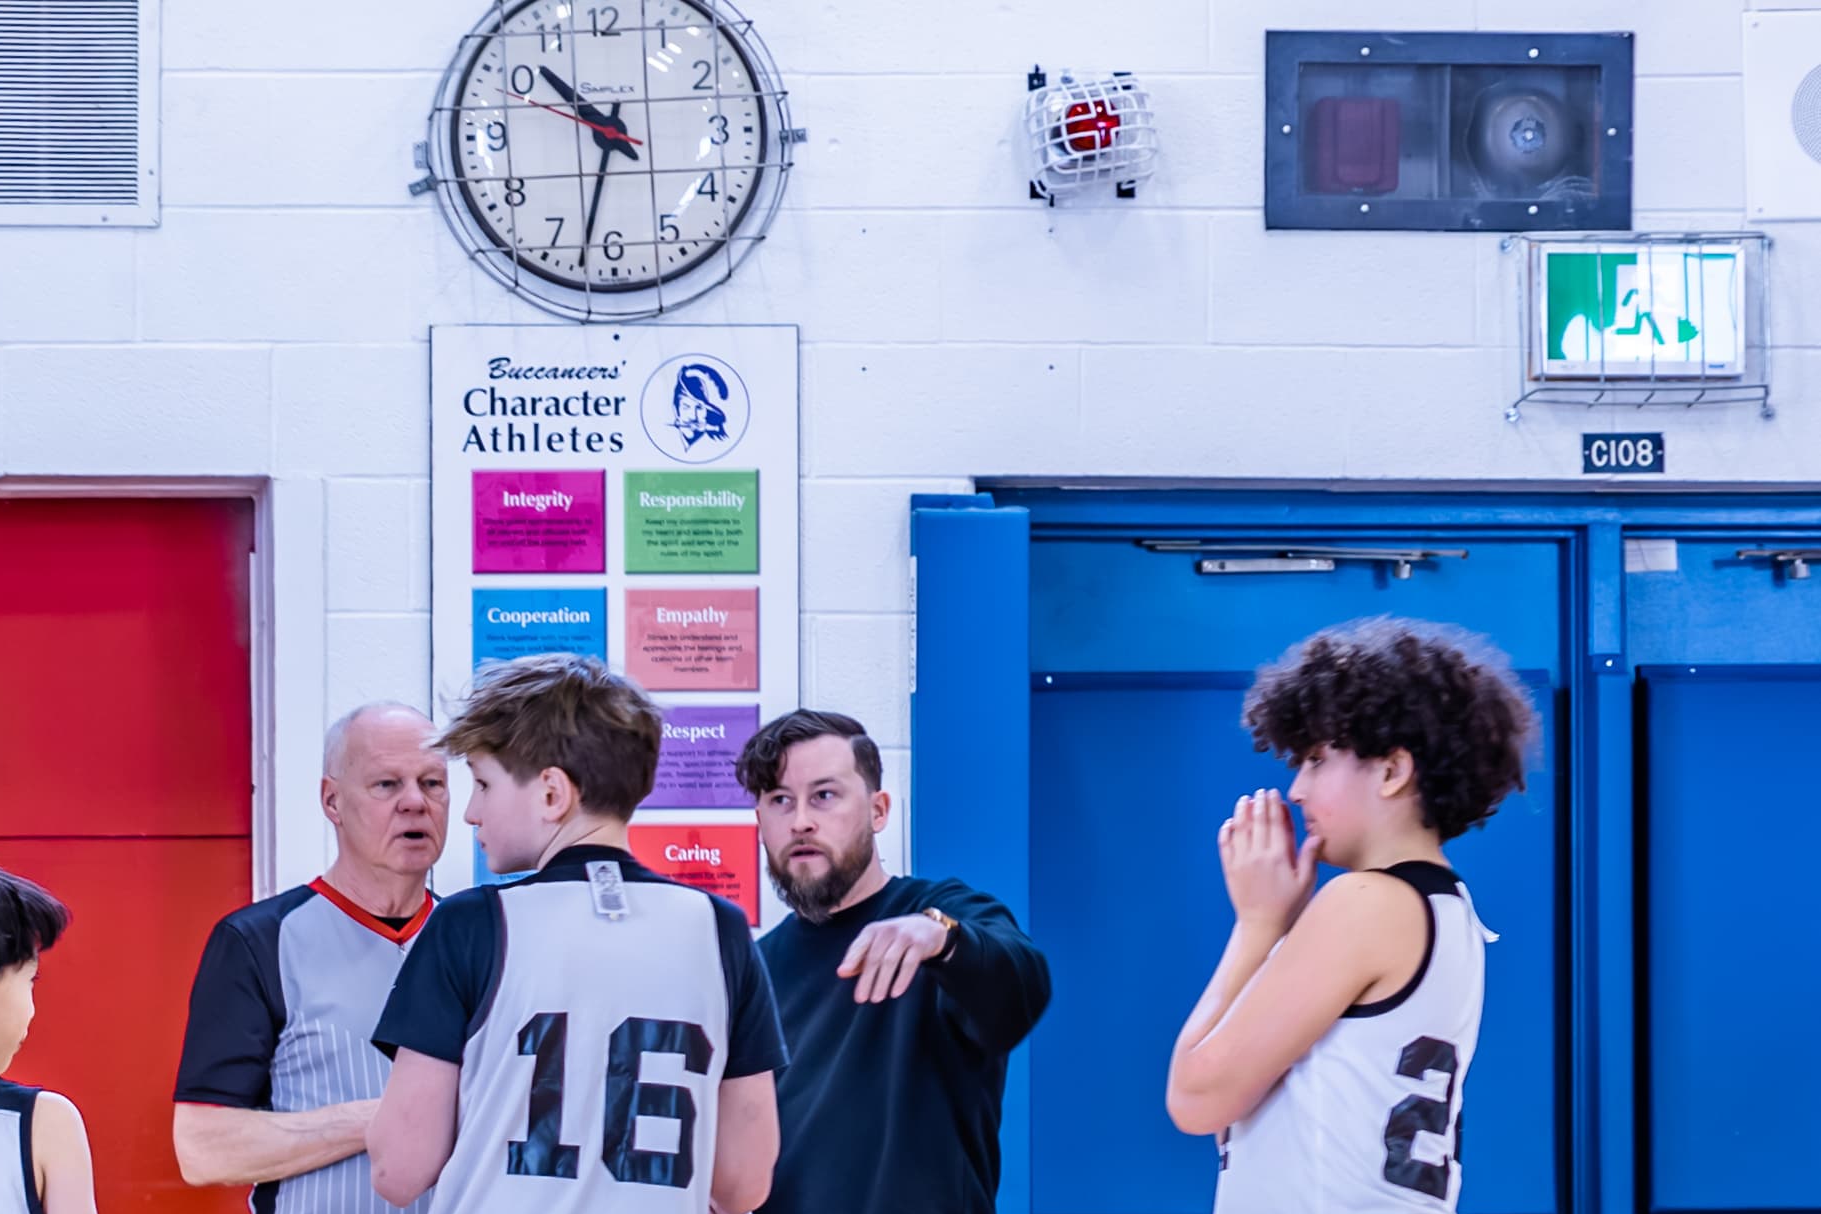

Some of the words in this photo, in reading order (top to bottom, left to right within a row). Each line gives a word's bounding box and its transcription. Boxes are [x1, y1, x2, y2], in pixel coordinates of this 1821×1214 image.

[586, 6, 622, 36] 12
[655, 19, 668, 49] 1
[539, 23, 564, 53] 11
[692, 60, 713, 90] 2
[486, 120, 507, 152] 9
[709, 115, 730, 146] 3
[504, 177, 527, 207] 8
[696, 171, 719, 202] 4
[545, 217, 565, 247] 7
[659, 213, 681, 243] 5
[603, 230, 625, 261] 6
[463, 386, 627, 417] Character
[462, 423, 624, 453] Athletes
[1590, 438, 1654, 467] C108
[502, 490, 574, 512] Integrity
[639, 490, 746, 512] Responsibility
[486, 606, 591, 628] Cooperation
[655, 606, 729, 627] Empathy
[661, 722, 726, 744] Respect
[664, 844, 722, 865] Caring
[507, 1012, 714, 1189] 16
